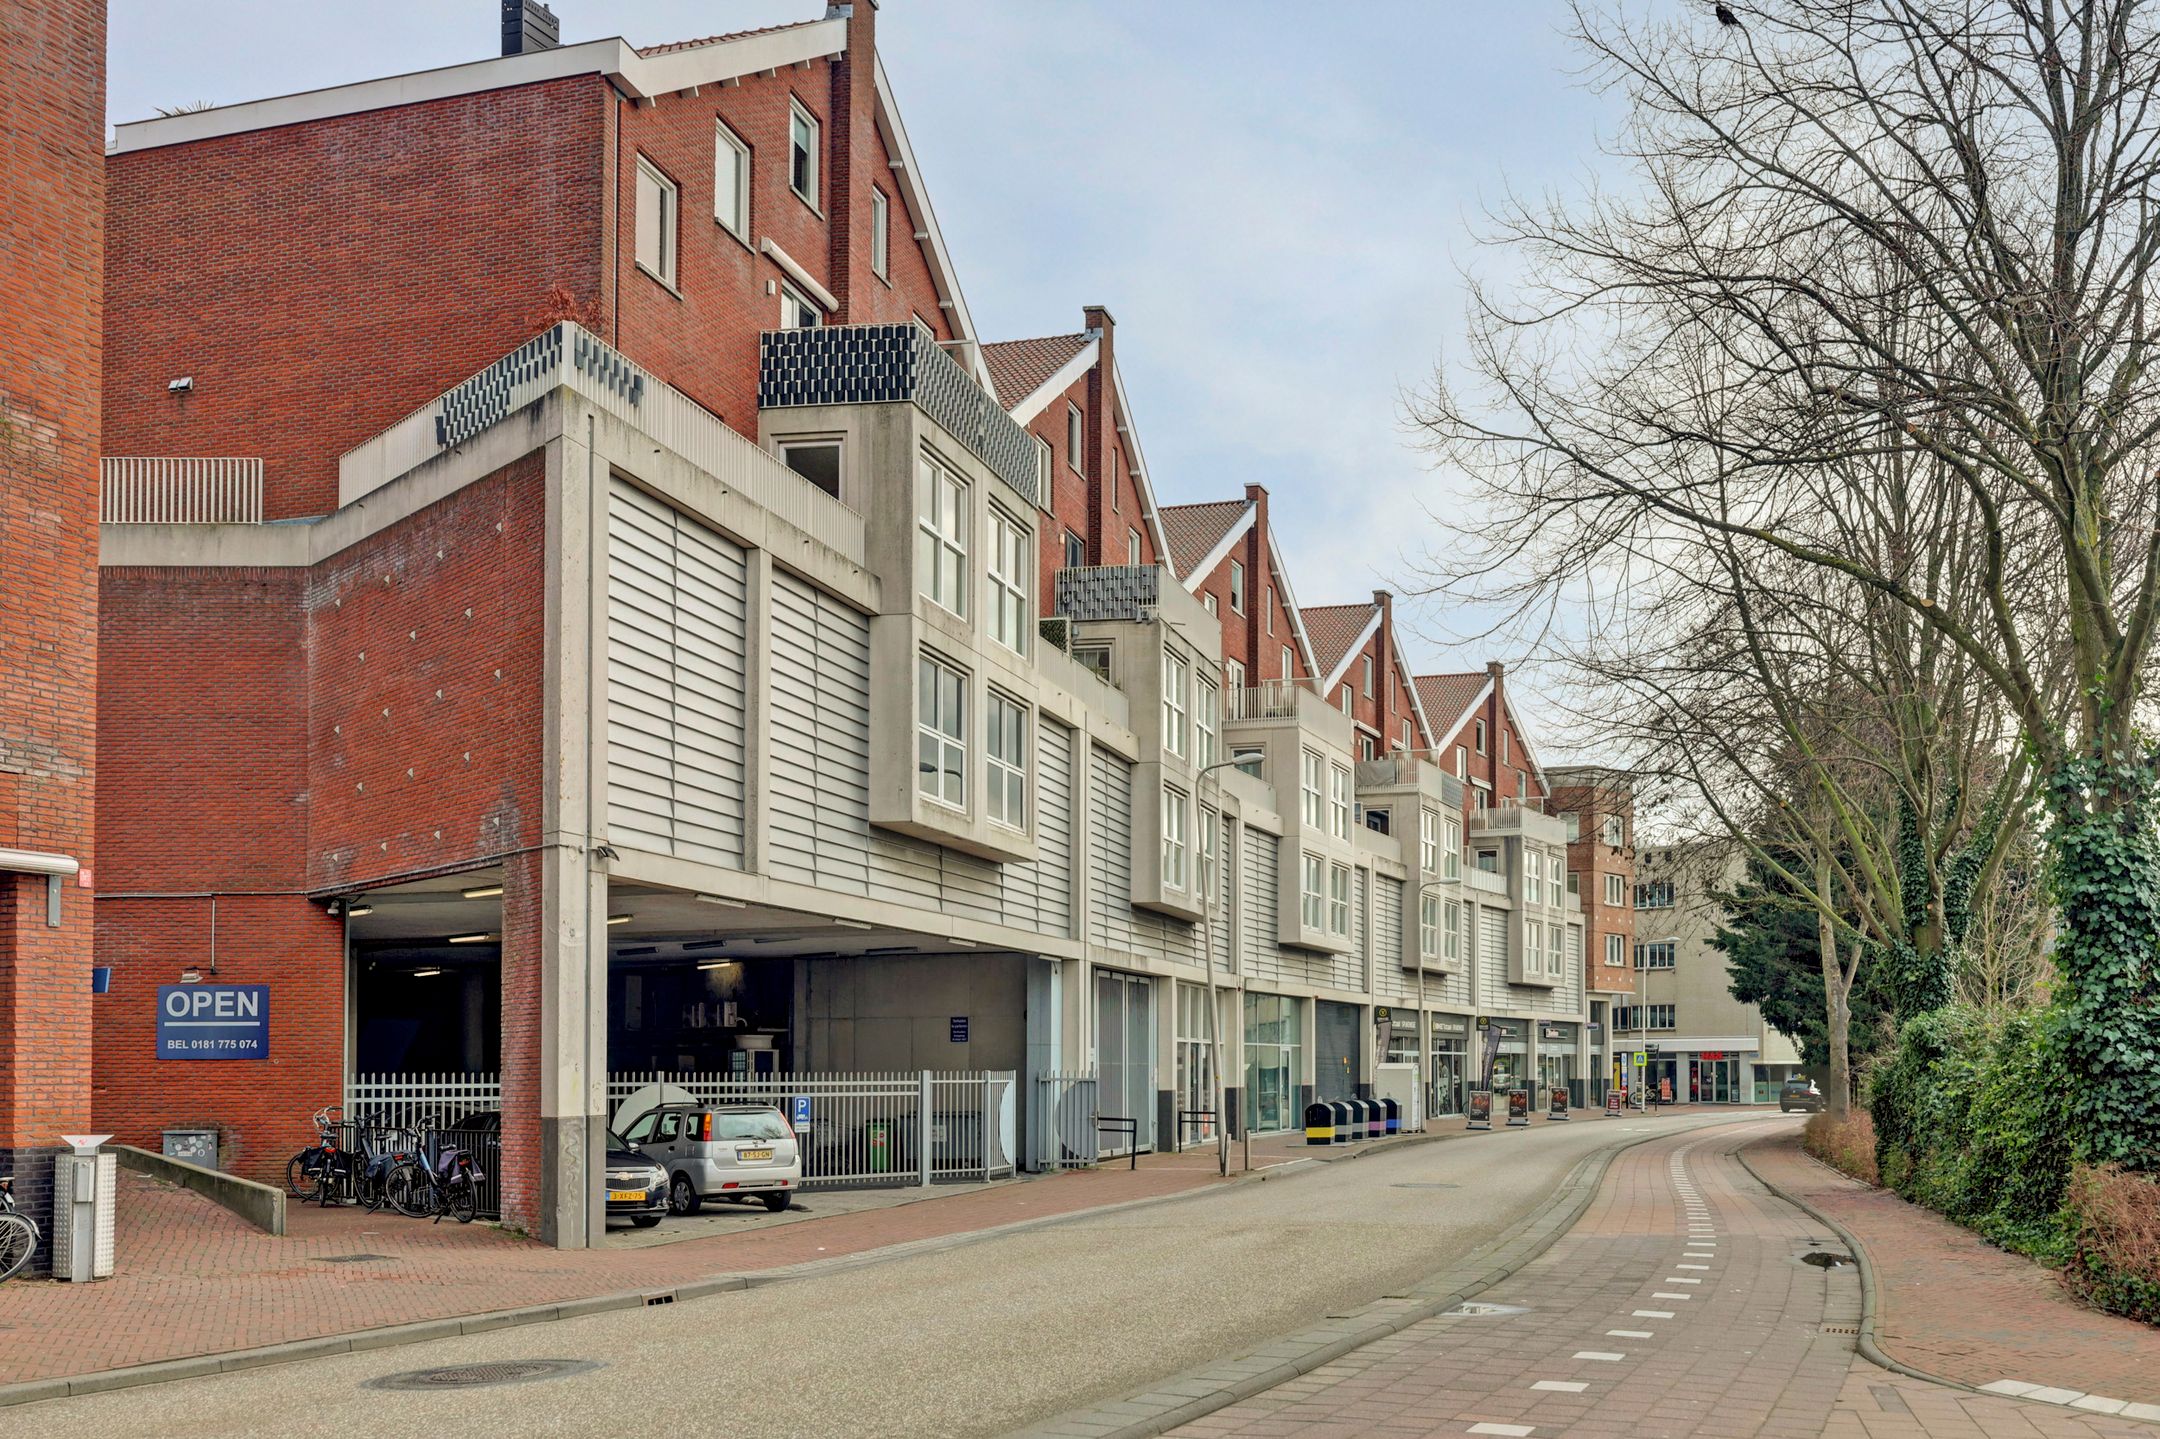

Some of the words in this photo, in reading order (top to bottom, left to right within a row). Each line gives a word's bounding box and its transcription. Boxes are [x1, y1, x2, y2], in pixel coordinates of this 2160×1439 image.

[166, 991, 259, 1017] OPEN
[167, 1040, 189, 1049] BEL
[191, 1040, 215, 1049] 0181
[218, 1040, 237, 1049] 775
[239, 1040, 258, 1049] 074
[798, 1099, 807, 1113] P
